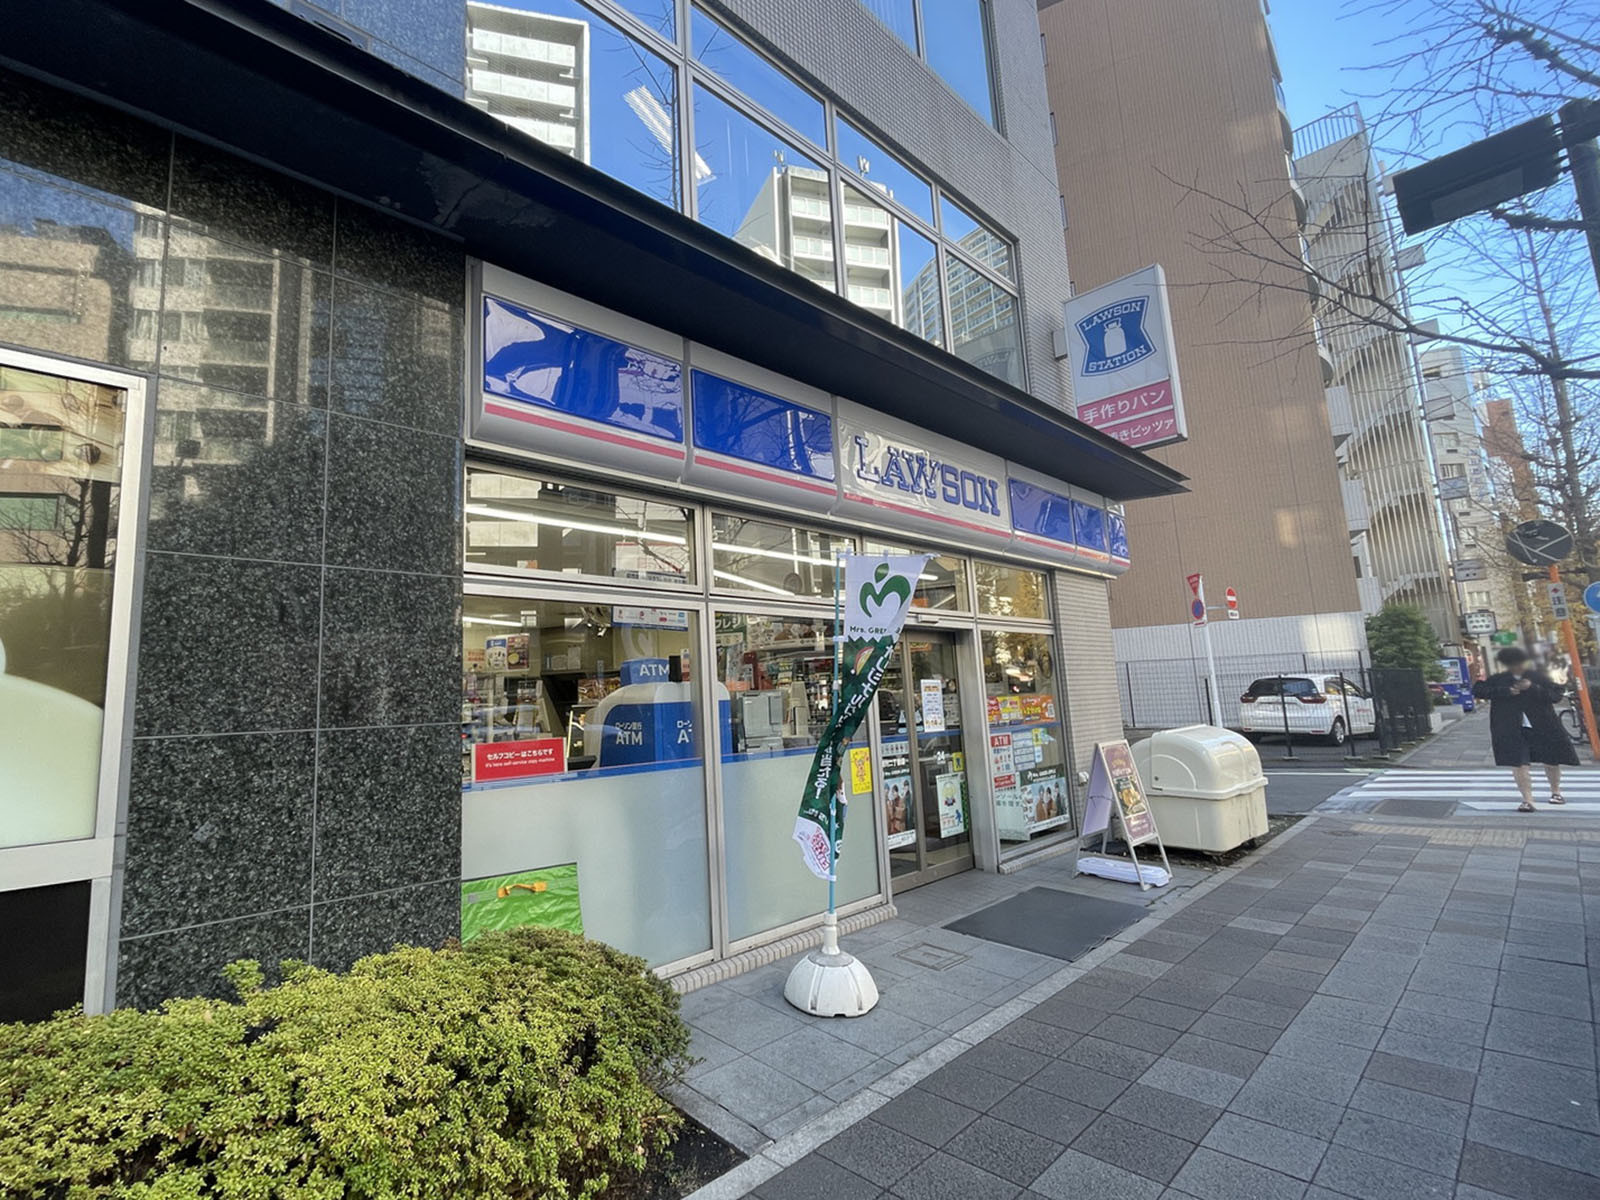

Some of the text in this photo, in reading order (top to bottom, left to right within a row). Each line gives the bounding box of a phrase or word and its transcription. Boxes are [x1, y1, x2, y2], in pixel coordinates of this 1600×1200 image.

[1082, 301, 1142, 331] LAWSON
[1088, 344, 1147, 372] STATION
[1083, 390, 1165, 424] 手作りパン
[854, 435, 1001, 517] LAWSON
[639, 664, 670, 676] ATM
[615, 731, 643, 746] ATM
[676, 728, 692, 744] A
[486, 748, 553, 760] セルフコピーはこちらです
